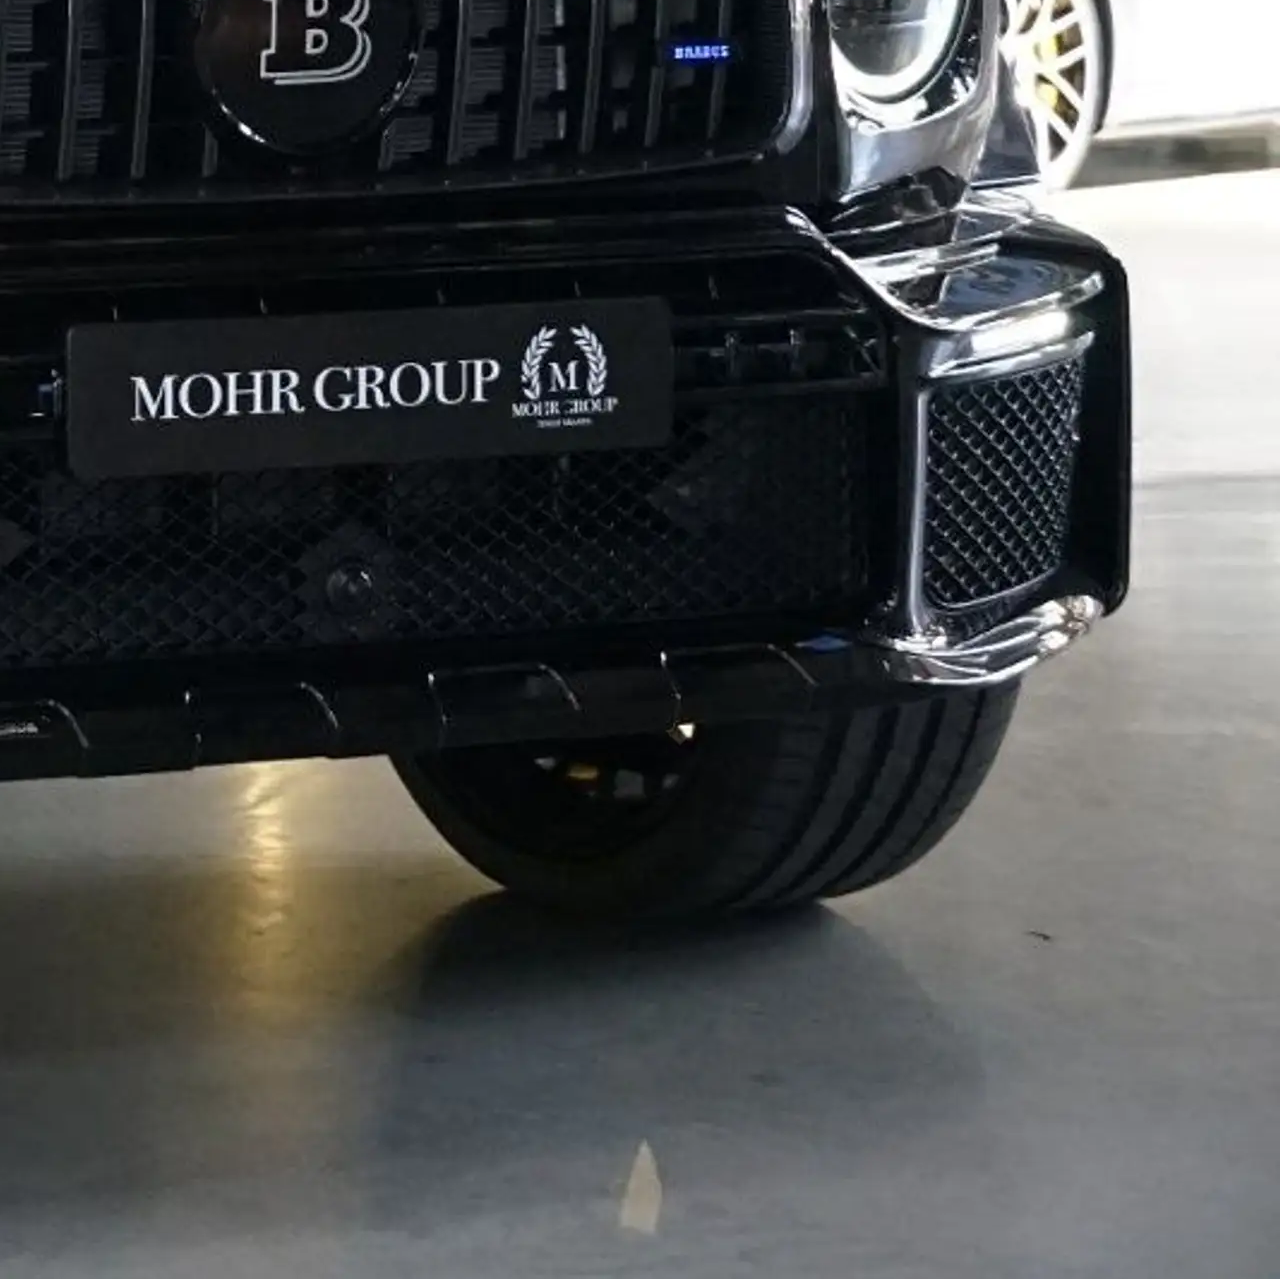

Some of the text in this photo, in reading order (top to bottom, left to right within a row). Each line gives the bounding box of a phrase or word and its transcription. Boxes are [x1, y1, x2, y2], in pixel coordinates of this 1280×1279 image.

[130, 358, 500, 421] MOHR GROUP
[548, 360, 579, 392] M
